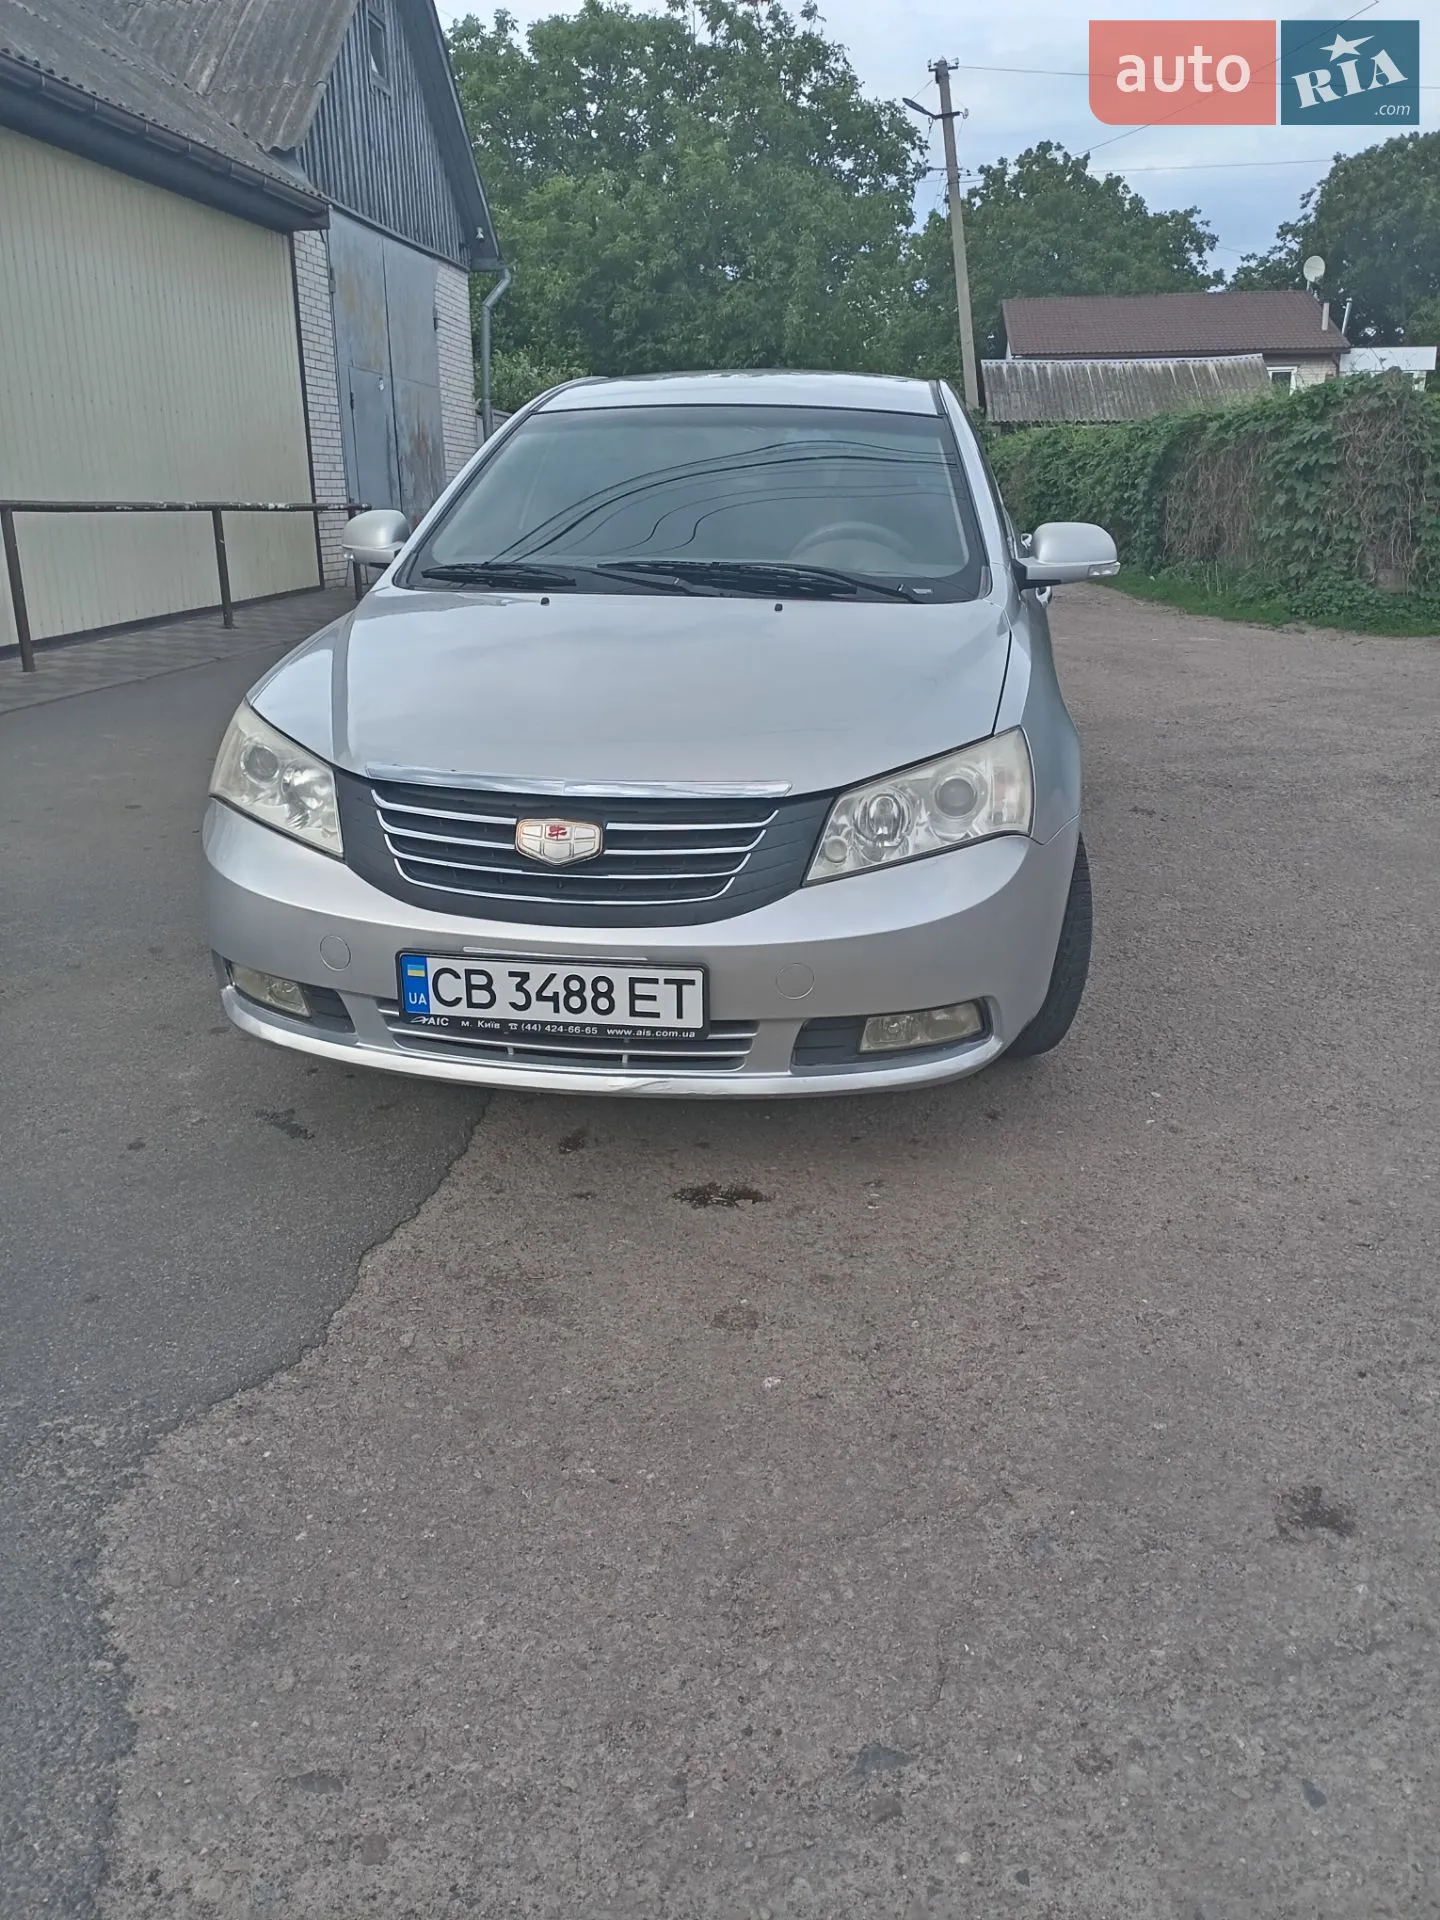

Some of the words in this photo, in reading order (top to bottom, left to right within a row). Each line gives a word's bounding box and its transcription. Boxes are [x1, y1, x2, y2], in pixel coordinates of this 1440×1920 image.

[408, 992, 427, 1006] UA
[432, 967, 497, 1010] CB
[507, 970, 616, 1016] 3488
[628, 976, 696, 1020] ET
[477, 1020, 501, 1030] Київ
[521, 1023, 542, 1032] (44)
[544, 1023, 598, 1035] 424-66-65
[606, 1028, 696, 1038] www.ais.com.ua
